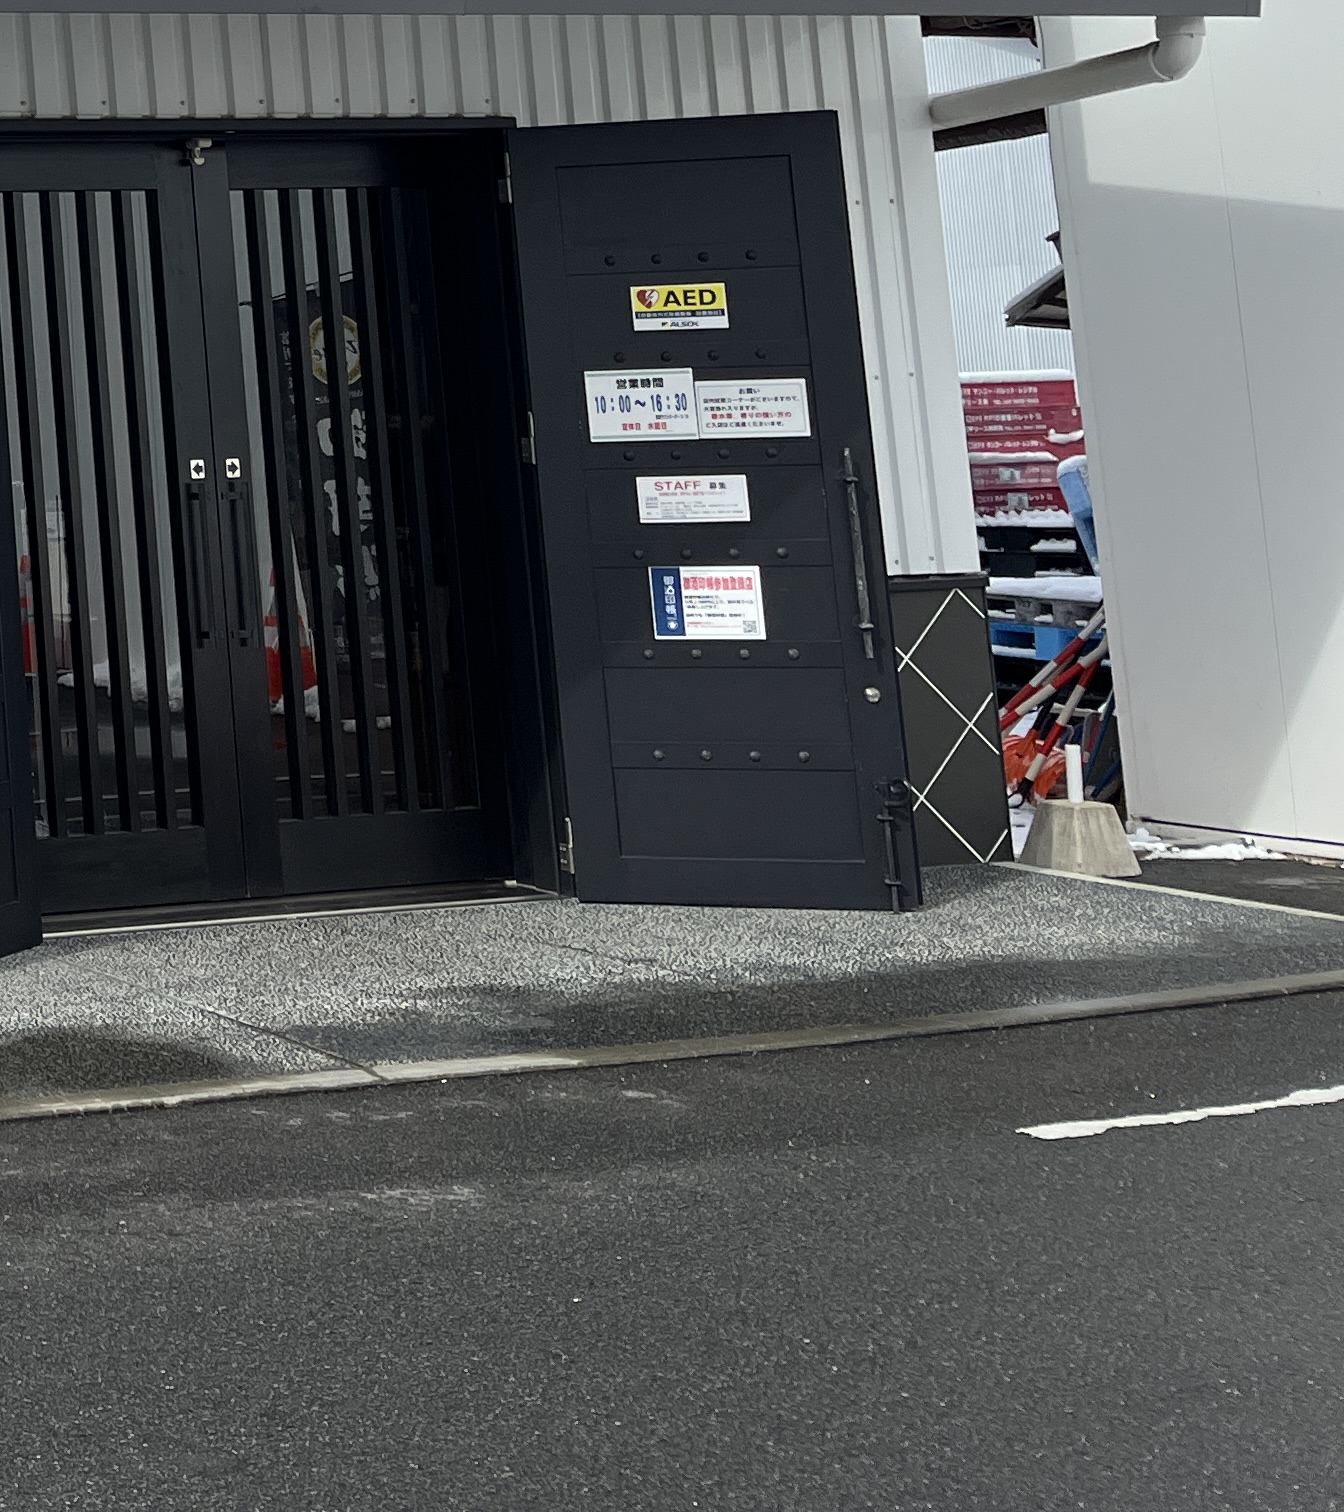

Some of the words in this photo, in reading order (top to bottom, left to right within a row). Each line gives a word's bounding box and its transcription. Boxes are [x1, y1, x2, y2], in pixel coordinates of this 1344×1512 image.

[663, 289, 717, 307] AED
[616, 378, 664, 389] 営業時間
[654, 480, 702, 492] STAFF
